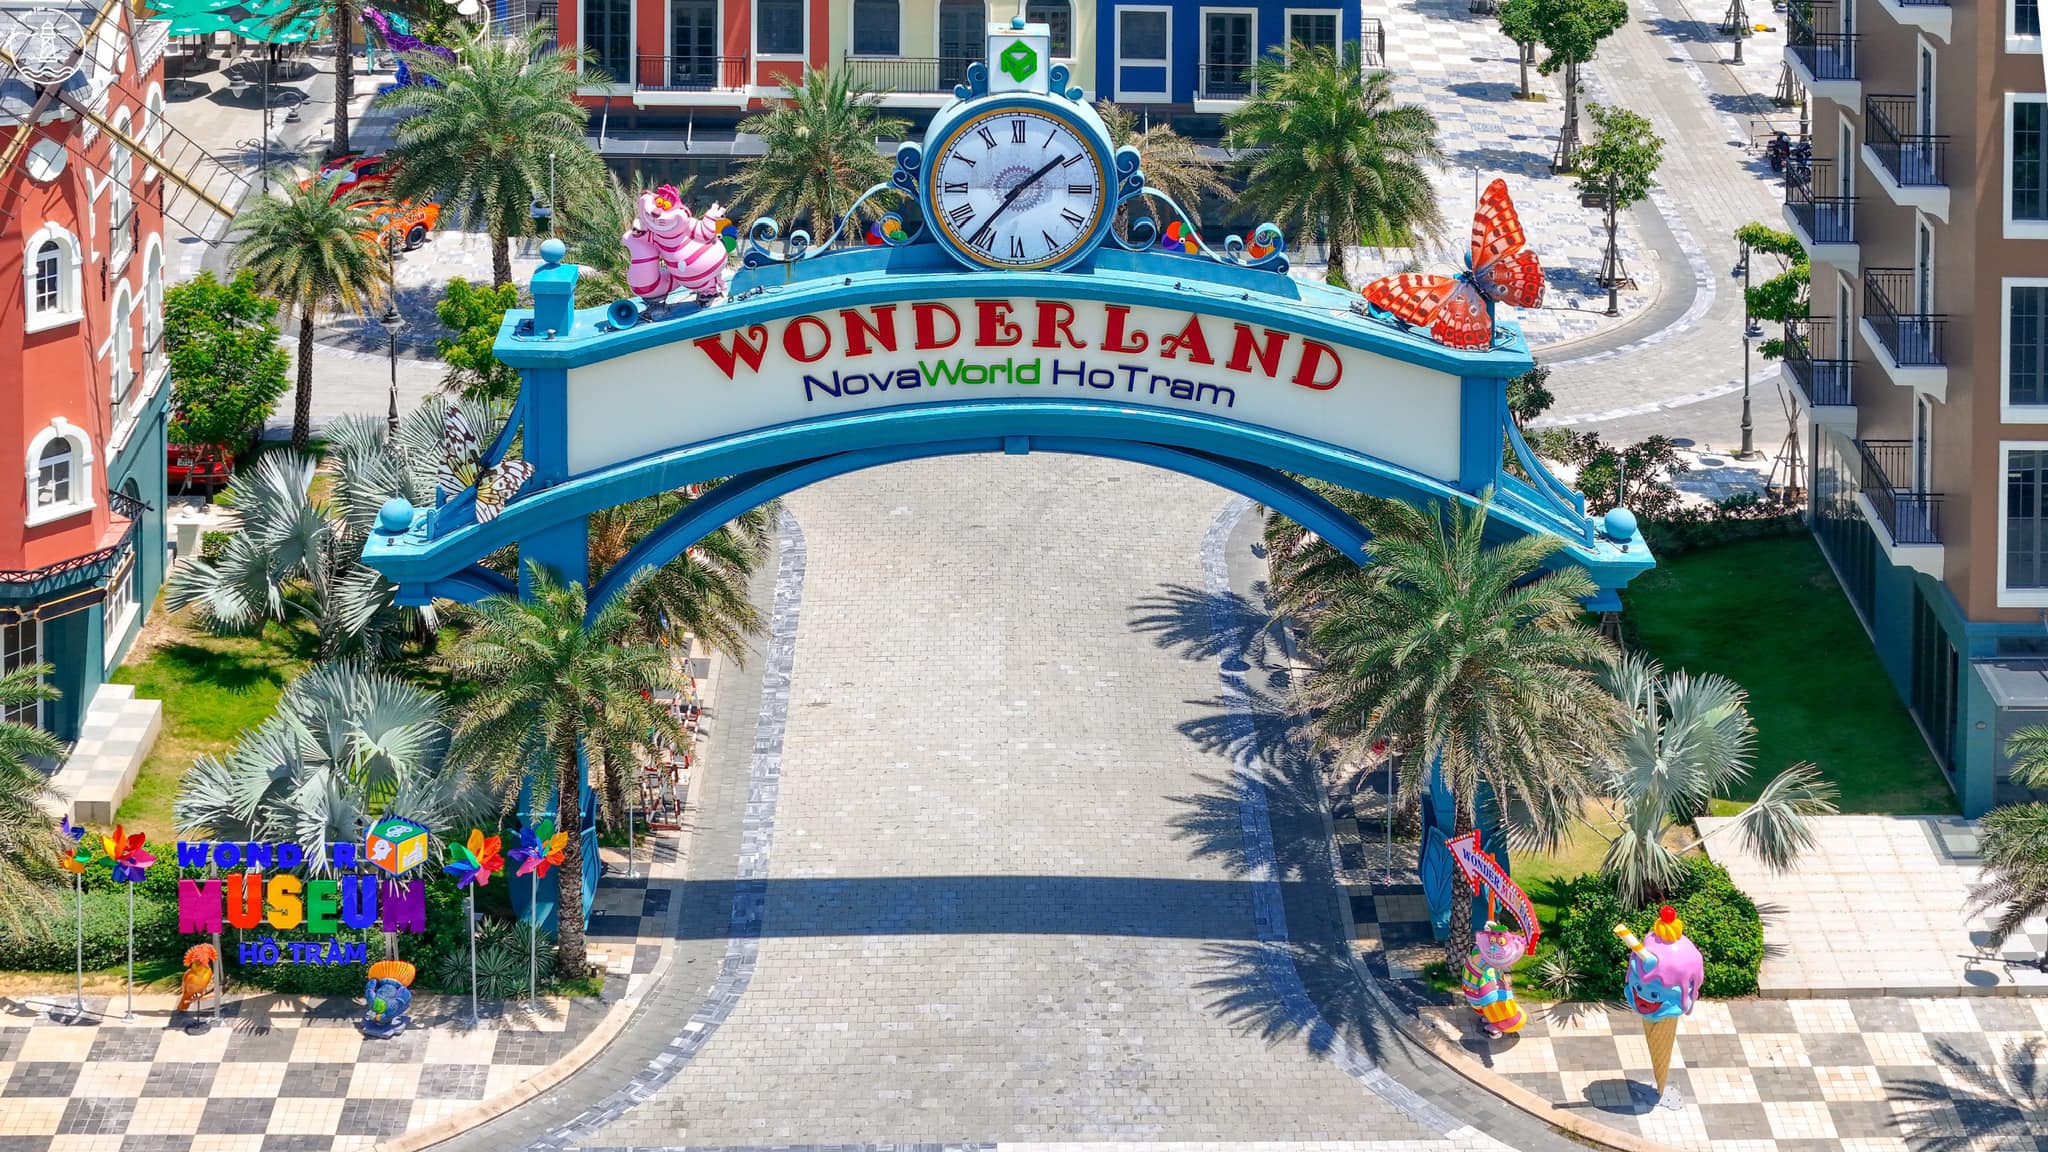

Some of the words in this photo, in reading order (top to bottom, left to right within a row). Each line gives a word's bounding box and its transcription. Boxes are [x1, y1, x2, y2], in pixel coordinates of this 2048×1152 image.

[977, 126, 998, 150] XI
[1011, 119, 1027, 144] XII
[1061, 153, 1084, 168] II
[1068, 184, 1092, 194] III
[693, 299, 1343, 391] WONDERLAND
[803, 357, 1041, 402] NovaWorld
[1052, 358, 1236, 408] HoTram
[177, 840, 358, 869] WONDR
[1462, 847, 1501, 890] WONDER
[178, 872, 427, 934] MUSEUM
[239, 934, 282, 966] HỒ
[287, 937, 367, 966] TRÀM
